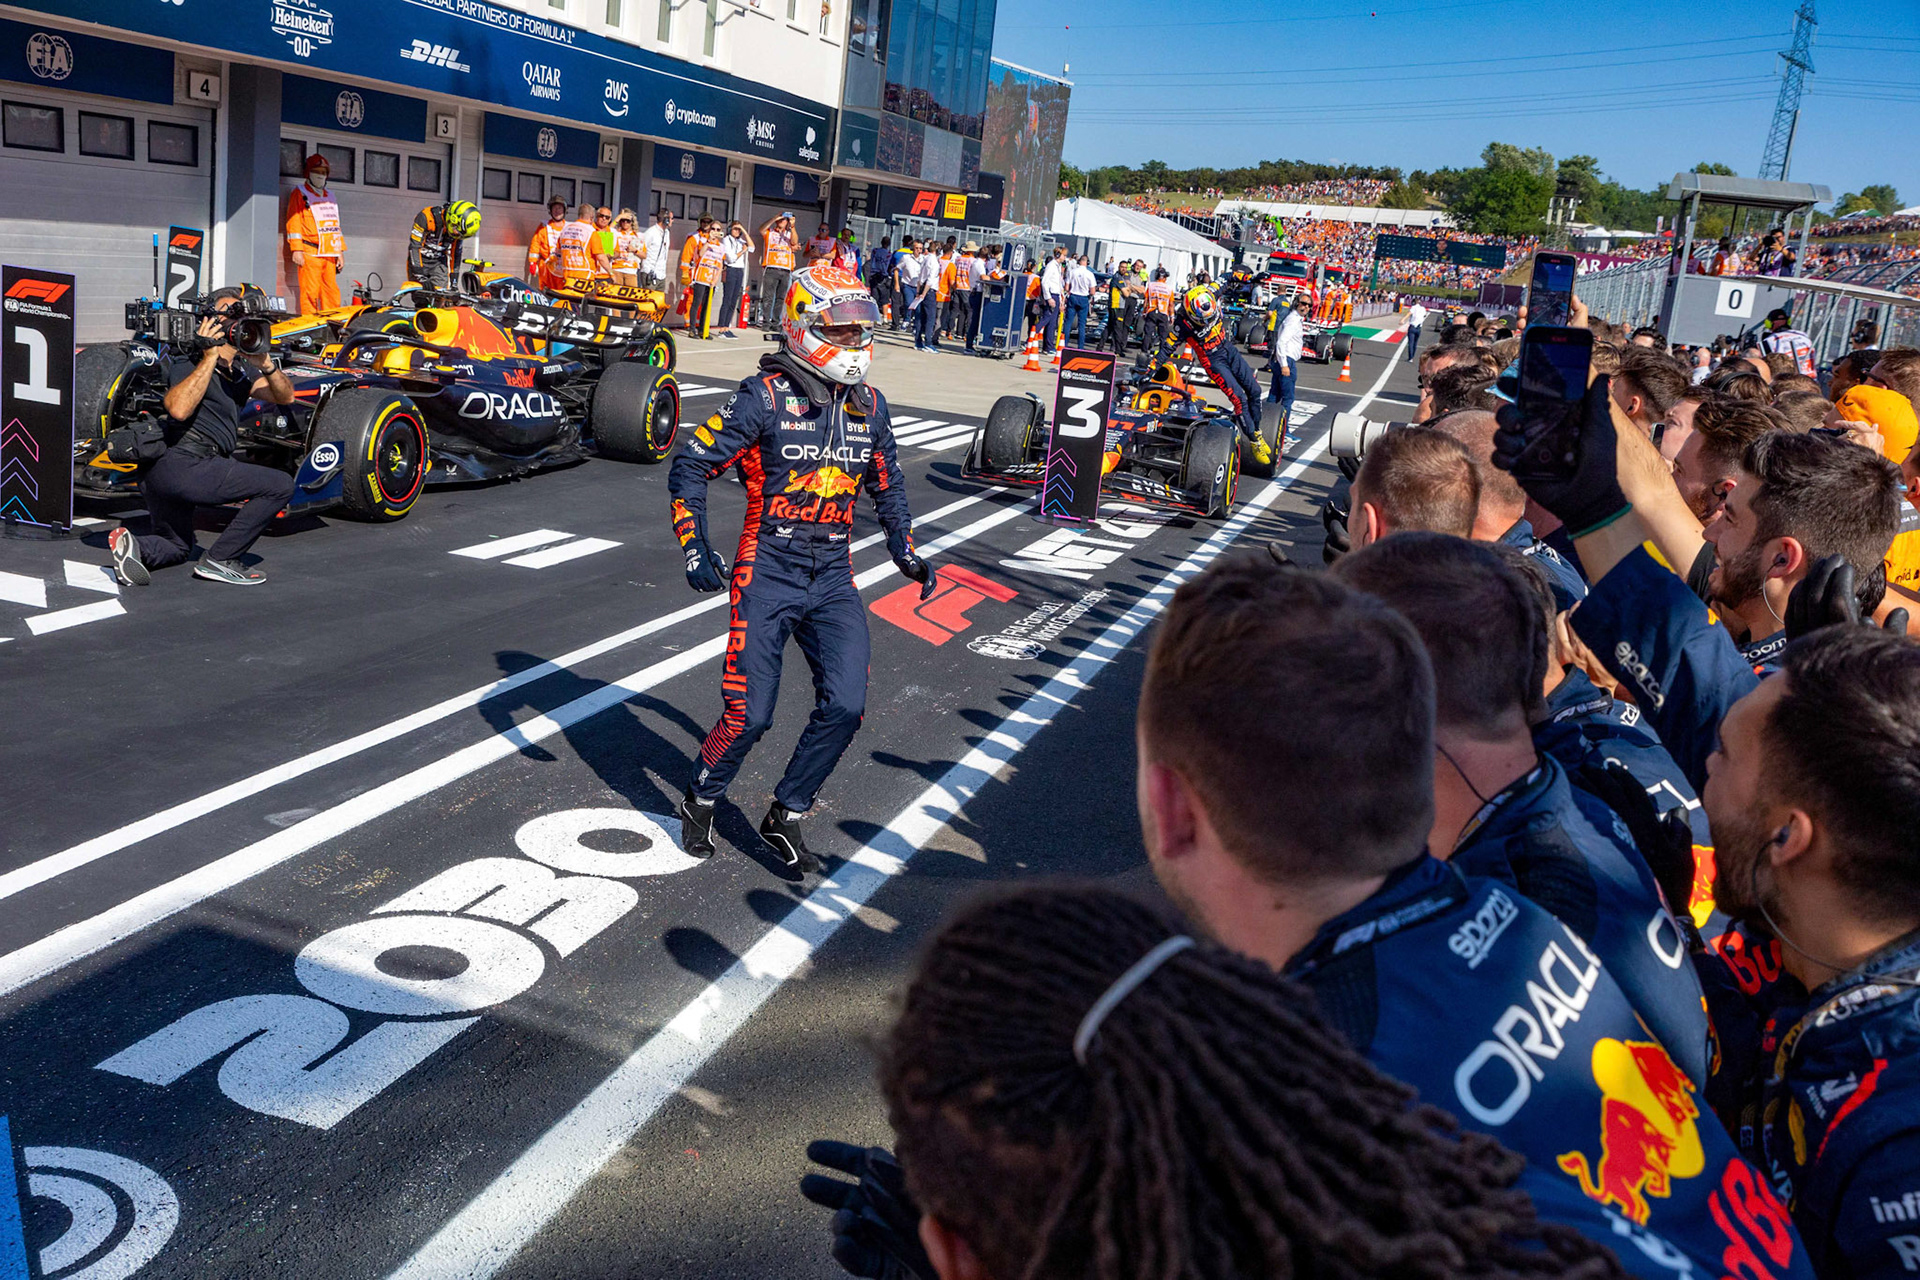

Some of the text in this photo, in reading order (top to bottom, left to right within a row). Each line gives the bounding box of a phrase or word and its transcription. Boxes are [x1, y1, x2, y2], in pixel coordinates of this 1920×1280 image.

[456, 0, 508, 26] PARTNERS
[509, 13, 523, 29] OF
[523, 18, 567, 42] FORMULA
[294, 36, 311, 58] 0.0
[408, 39, 463, 71] DHL
[522, 61, 561, 88] QATAR
[200, 78, 210, 97] 4
[529, 84, 561, 101] AIRWAYS
[605, 79, 629, 102] aws
[442, 119, 449, 134] 3
[676, 108, 716, 128] crypto.com
[756, 119, 776, 141] MSC
[608, 147, 614, 160] 2
[799, 147, 820, 162] salesforce
[946, 198, 965, 215] PIRELLI
[167, 262, 196, 313] 2
[1727, 288, 1743, 310] 0
[14, 326, 61, 406] 1
[542, 364, 563, 375] HONDA
[845, 365, 862, 376] EA
[458, 391, 563, 420] ORACLE
[1058, 385, 1105, 439] 3
[781, 421, 806, 432] Mobil
[846, 422, 871, 434] BYBIT
[845, 435, 872, 443] HONDA
[314, 450, 335, 464] Esso
[781, 444, 872, 463] ORACLE
[768, 495, 821, 522] Red
[998, 527, 1137, 581] NET
[722, 565, 754, 693] Red Bull
[1741, 637, 1788, 661] zoom
[1614, 640, 1665, 708] sparco
[1448, 887, 1519, 970] sparco
[93, 807, 705, 1131] 2030
